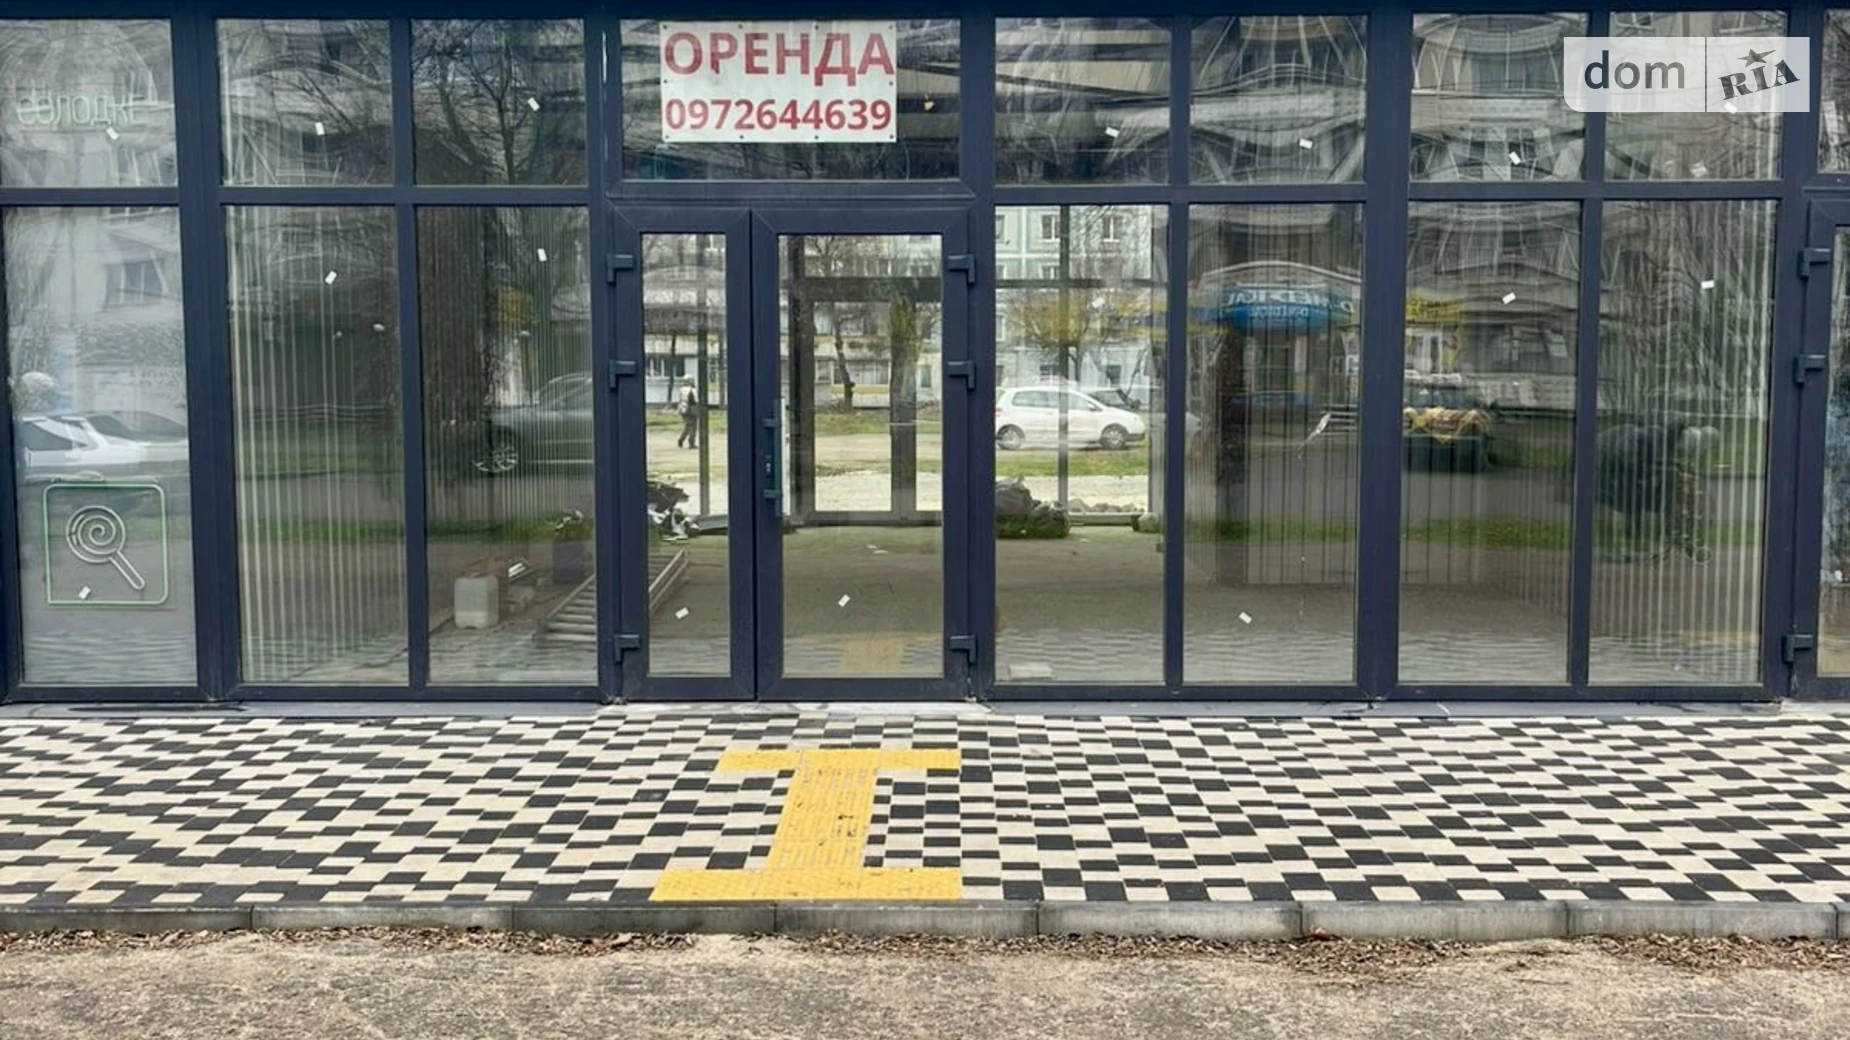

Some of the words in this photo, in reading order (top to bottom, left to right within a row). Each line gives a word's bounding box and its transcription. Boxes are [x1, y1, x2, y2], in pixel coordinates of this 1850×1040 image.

[664, 31, 895, 87] ОРЕНДА
[17, 95, 147, 126] СОЛОДКЕ
[665, 99, 892, 131] 0972644639
